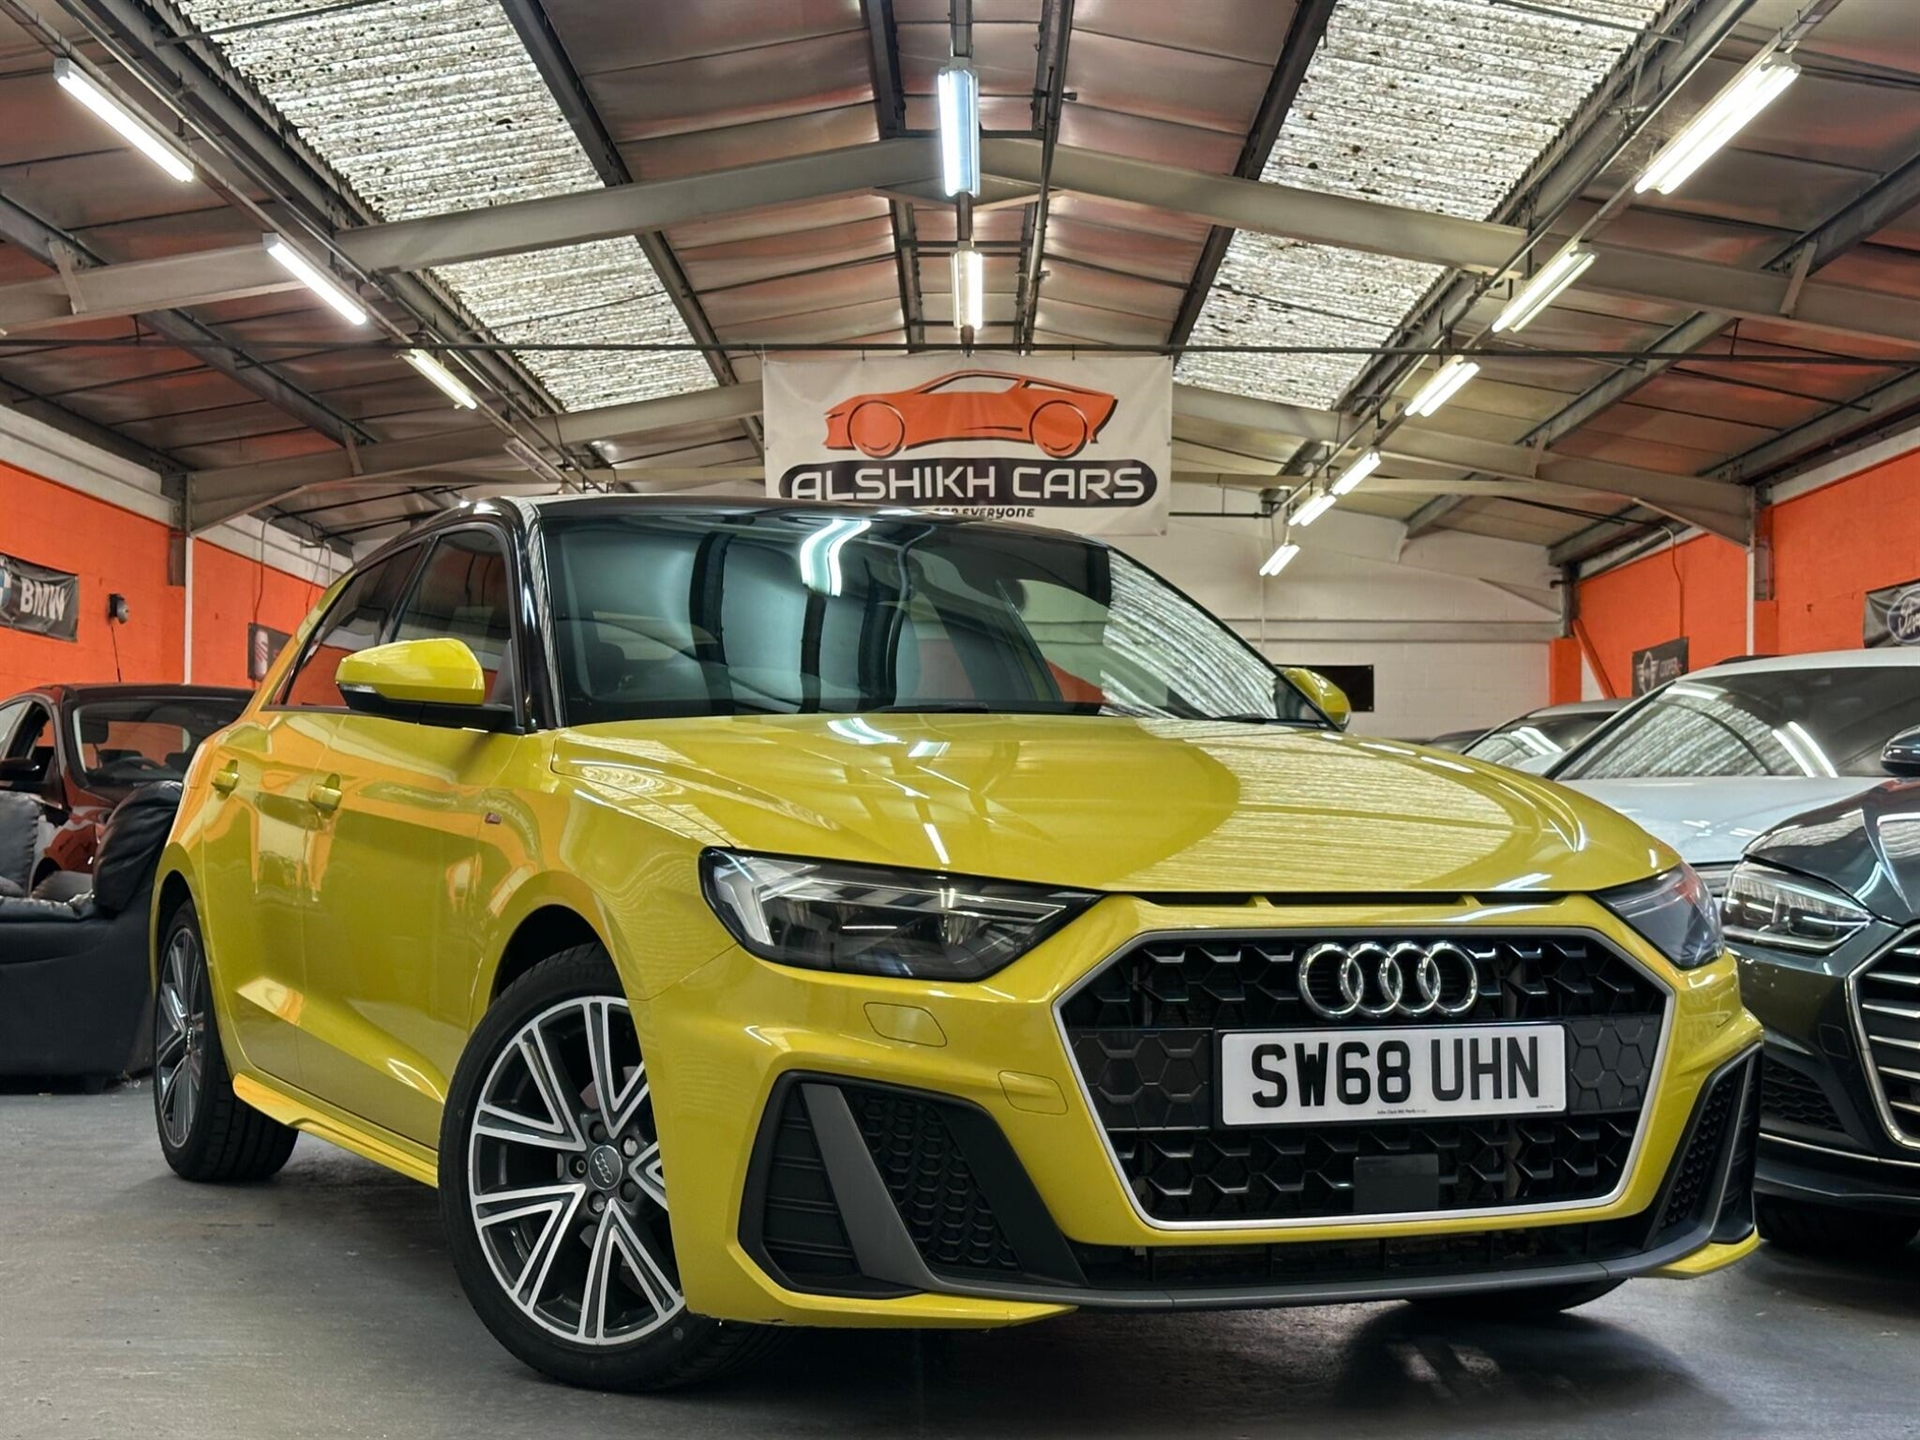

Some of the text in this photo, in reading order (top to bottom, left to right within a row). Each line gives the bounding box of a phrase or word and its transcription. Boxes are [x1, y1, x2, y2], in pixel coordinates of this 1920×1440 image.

[791, 466, 1146, 501] ALSHIKH CARS
[20, 577, 65, 621] BMW
[1251, 1036, 1539, 1108] SW68 UHN
